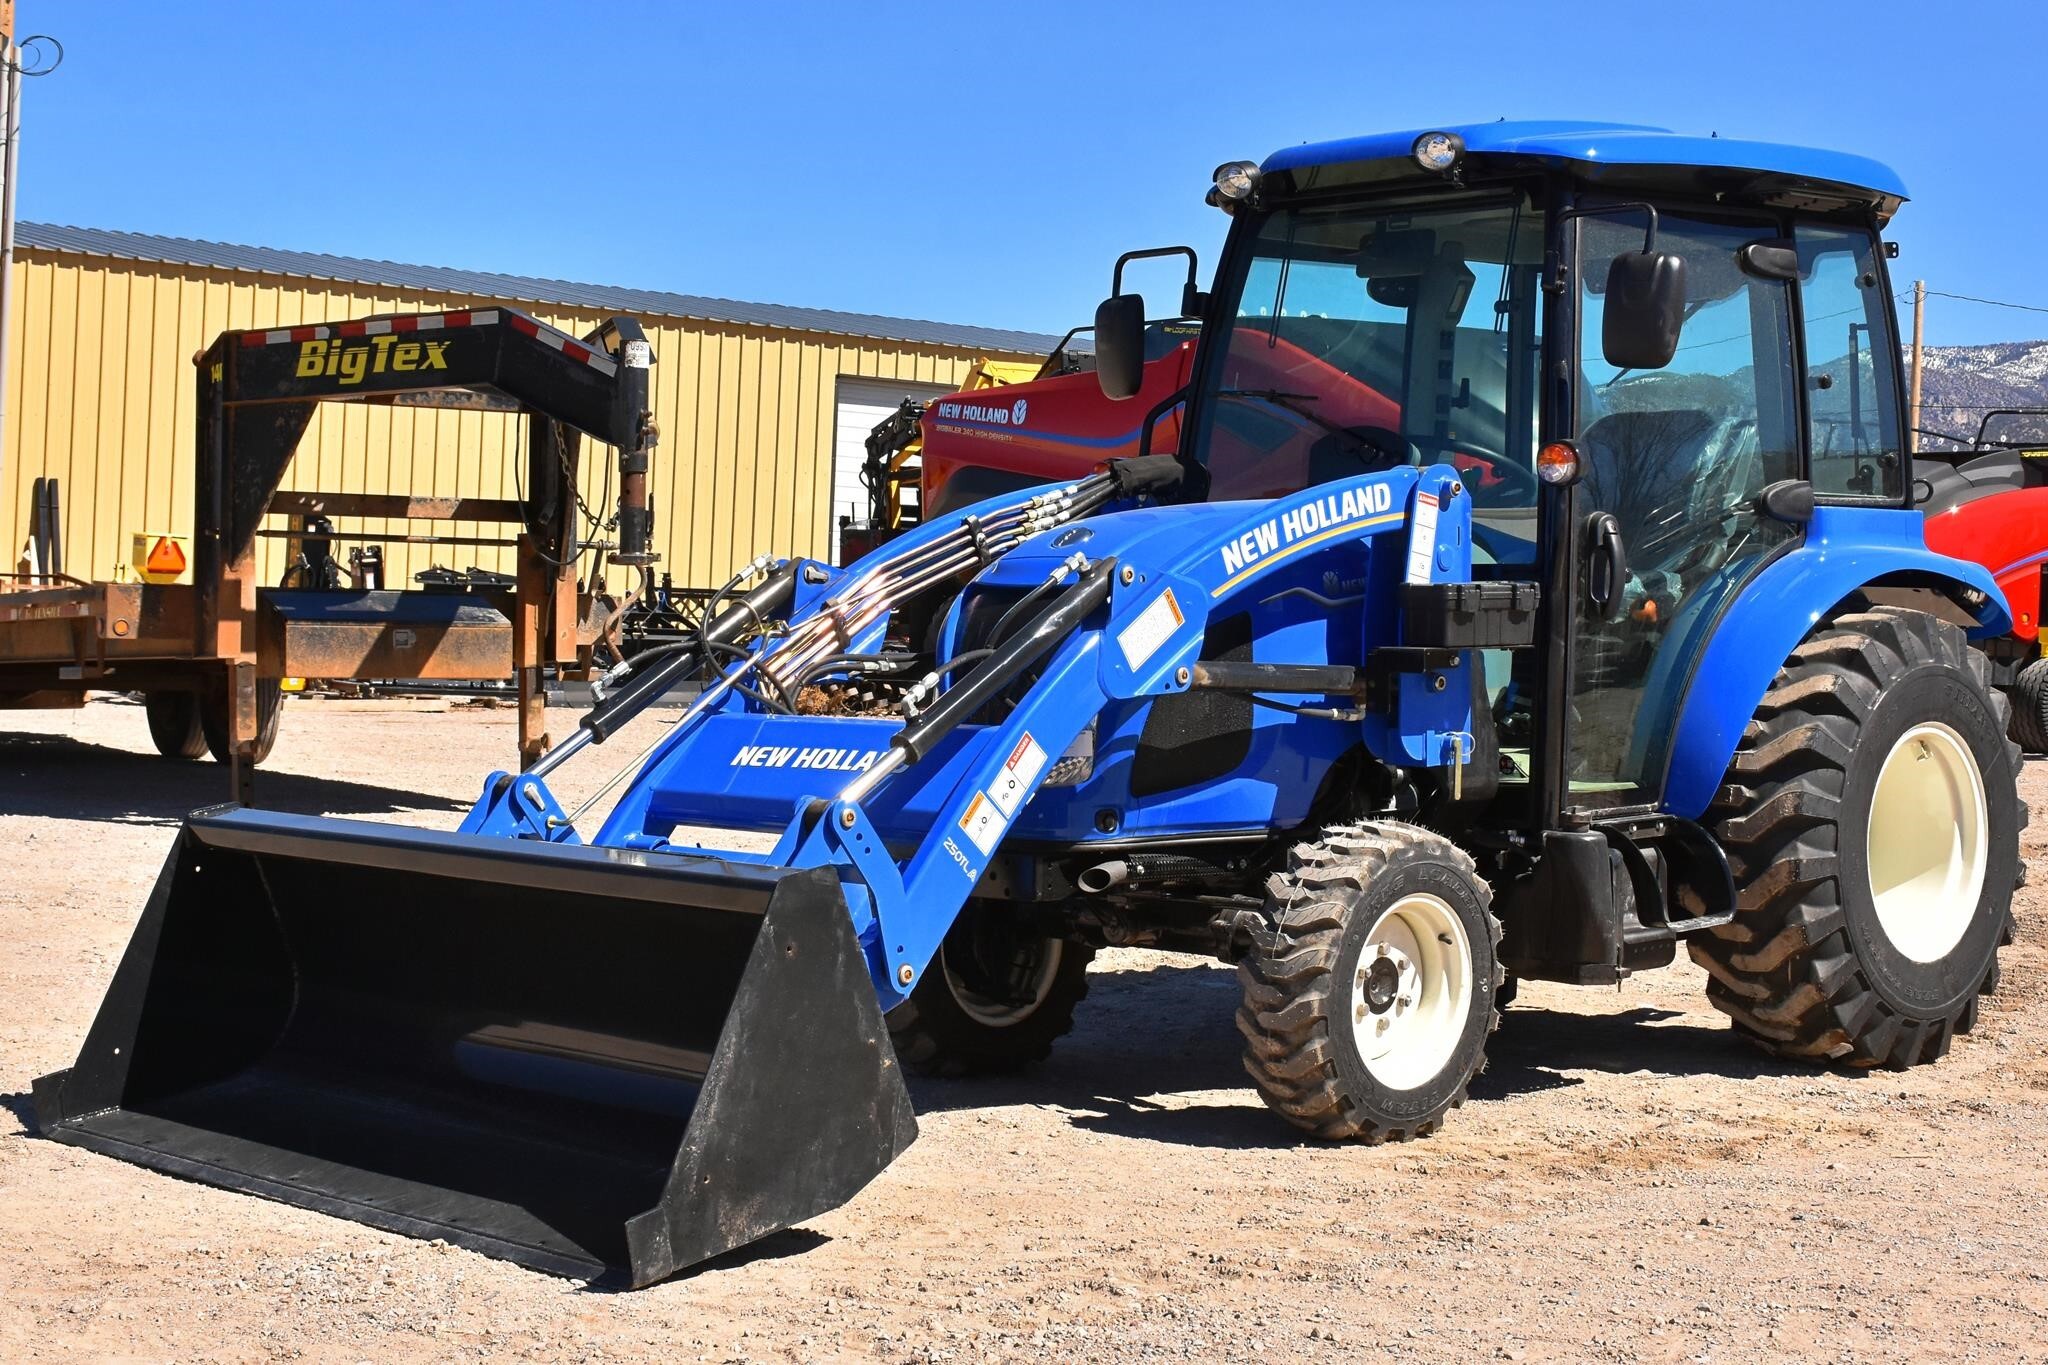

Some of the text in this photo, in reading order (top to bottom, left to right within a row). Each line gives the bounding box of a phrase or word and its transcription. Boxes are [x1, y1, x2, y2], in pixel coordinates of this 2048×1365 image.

[296, 335, 452, 385] BigTex
[938, 402, 1009, 425] NEW HOLLAND
[1220, 482, 1392, 576] NEW HOLLAND
[730, 745, 910, 774] NEW HOLLA
[1013, 736, 1030, 762] DANGER
[943, 836, 978, 883] 250TLA
